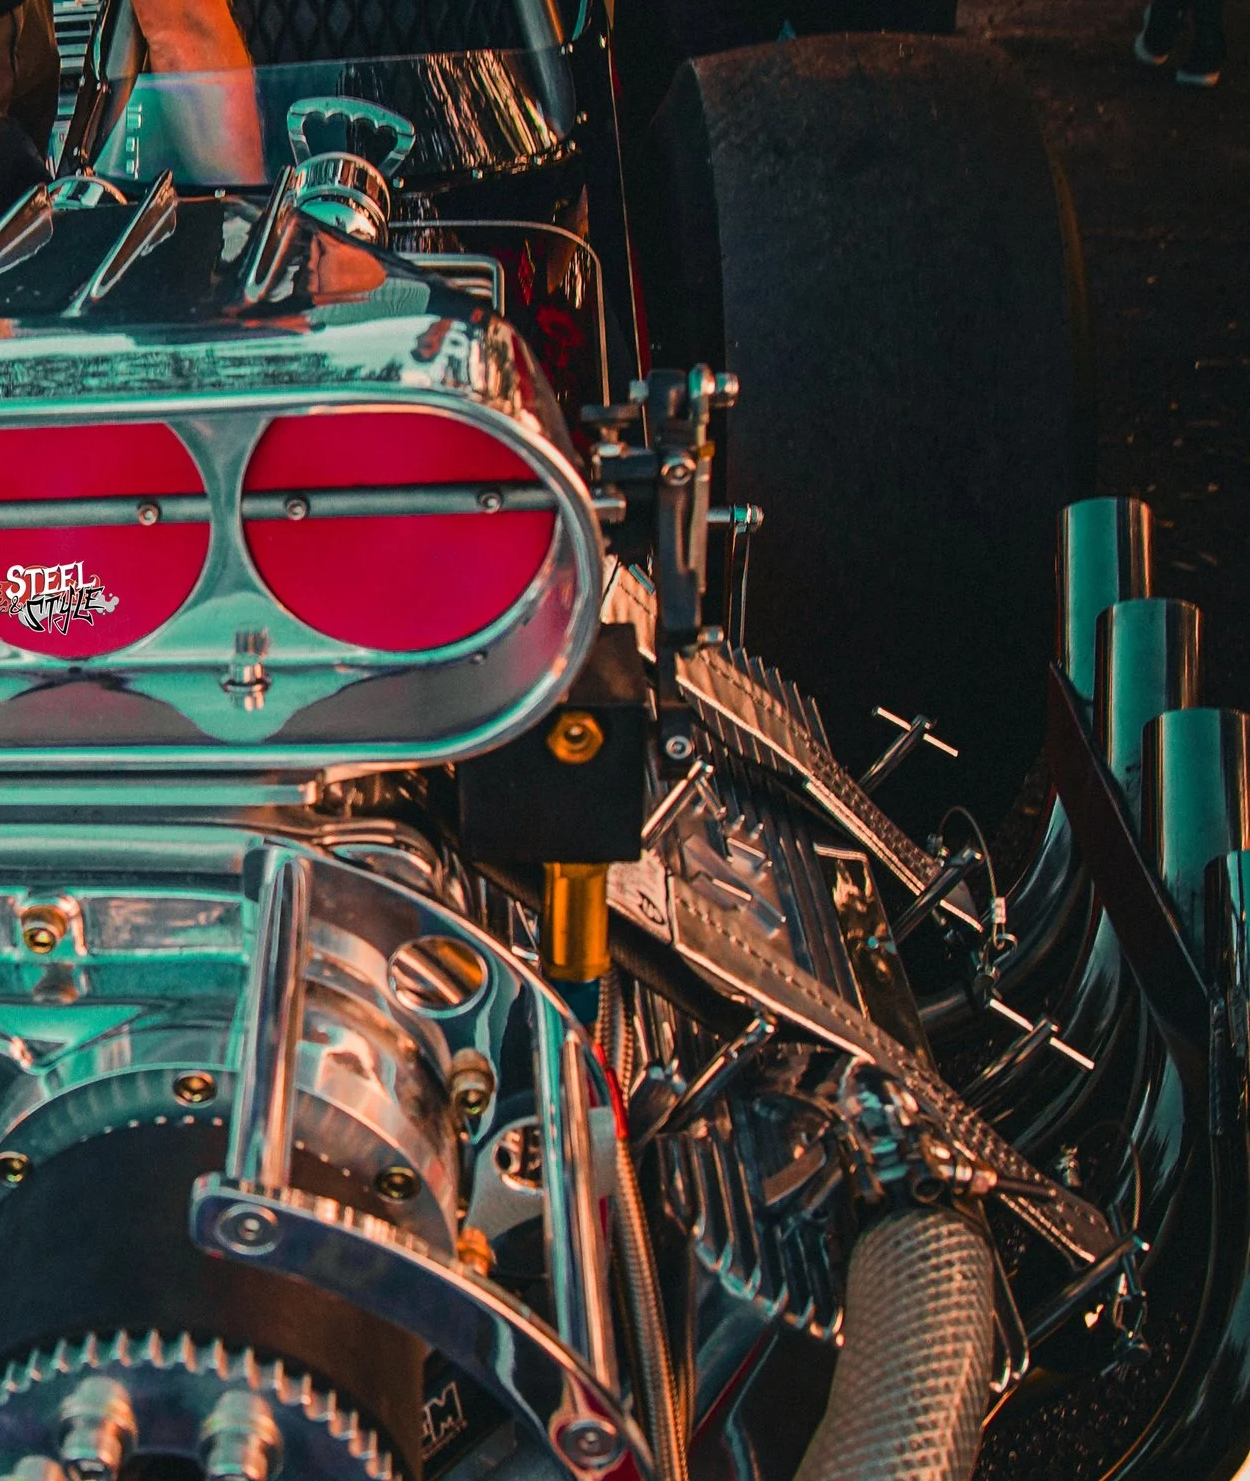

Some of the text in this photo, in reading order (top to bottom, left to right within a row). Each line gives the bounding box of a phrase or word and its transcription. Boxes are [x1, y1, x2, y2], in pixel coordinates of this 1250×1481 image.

[5, 560, 97, 600] STEEL
[9, 585, 105, 636] & STYLE
